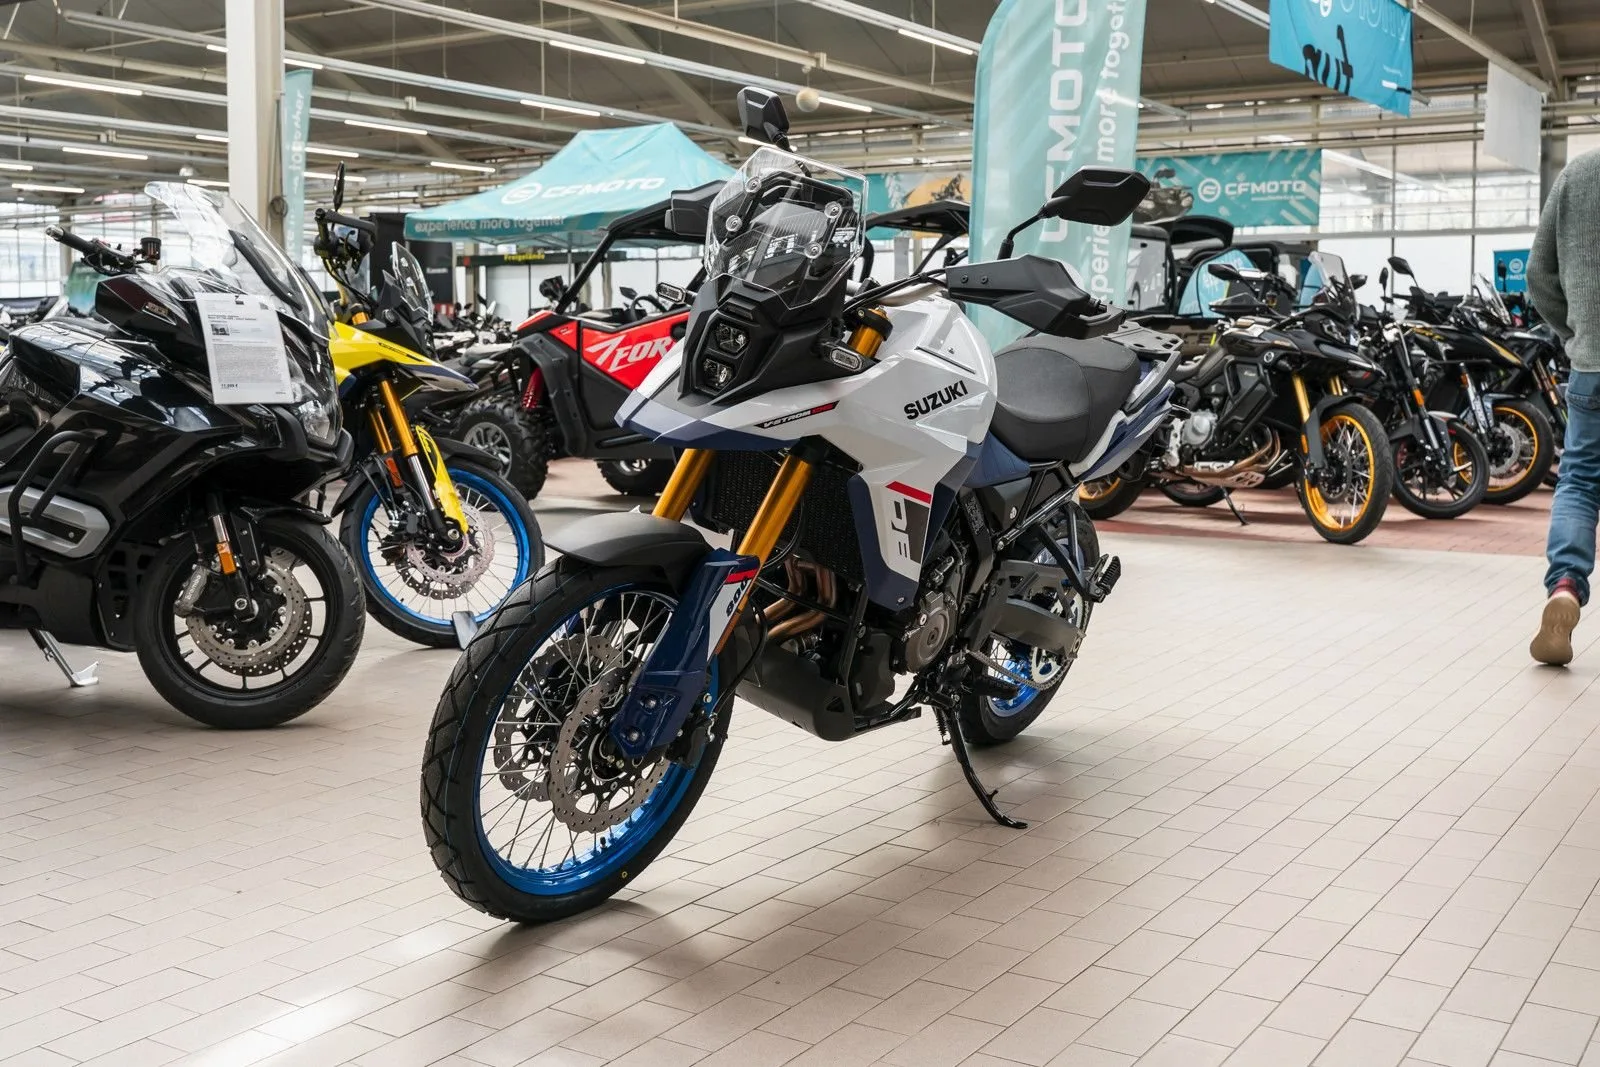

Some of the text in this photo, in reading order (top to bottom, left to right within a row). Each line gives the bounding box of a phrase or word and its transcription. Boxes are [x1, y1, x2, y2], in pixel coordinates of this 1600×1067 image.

[1100, 0, 1130, 79] toget
[541, 177, 665, 199] CFMOTO
[1225, 180, 1306, 196] CFMOTO
[414, 218, 477, 236] experience
[479, 218, 510, 231] more
[903, 380, 969, 420] SUZUKI
[726, 577, 750, 617] 800
